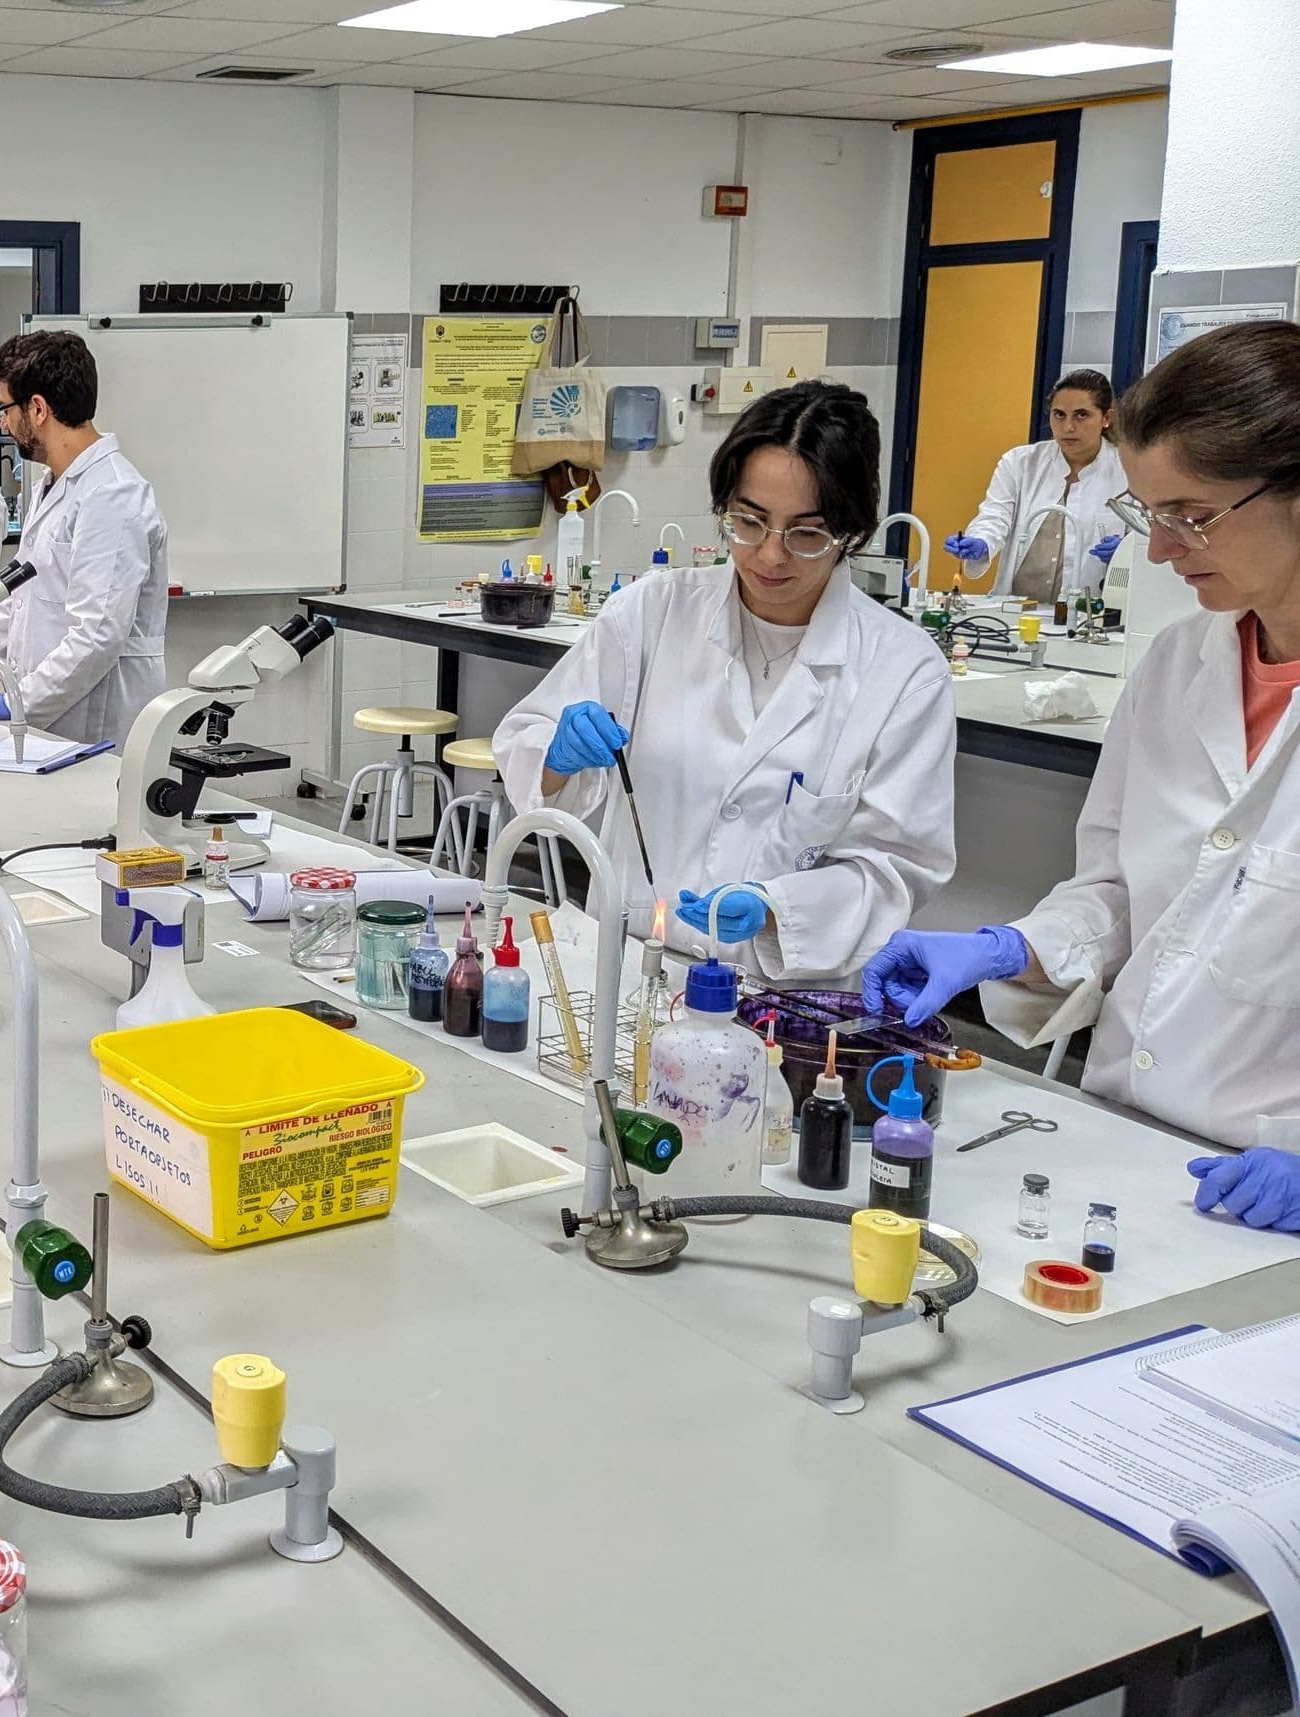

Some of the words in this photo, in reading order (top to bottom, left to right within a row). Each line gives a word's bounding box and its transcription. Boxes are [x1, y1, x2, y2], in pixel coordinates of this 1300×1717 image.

[302, 1114, 320, 1126] DE
[323, 1102, 379, 1121] LLENADO
[328, 1128, 354, 1143] RIESGO
[355, 1121, 392, 1138] BIOLÓGICO
[114, 1124, 191, 1186] PORTAOBJETOS
[242, 1145, 283, 1161] PELIGRO
